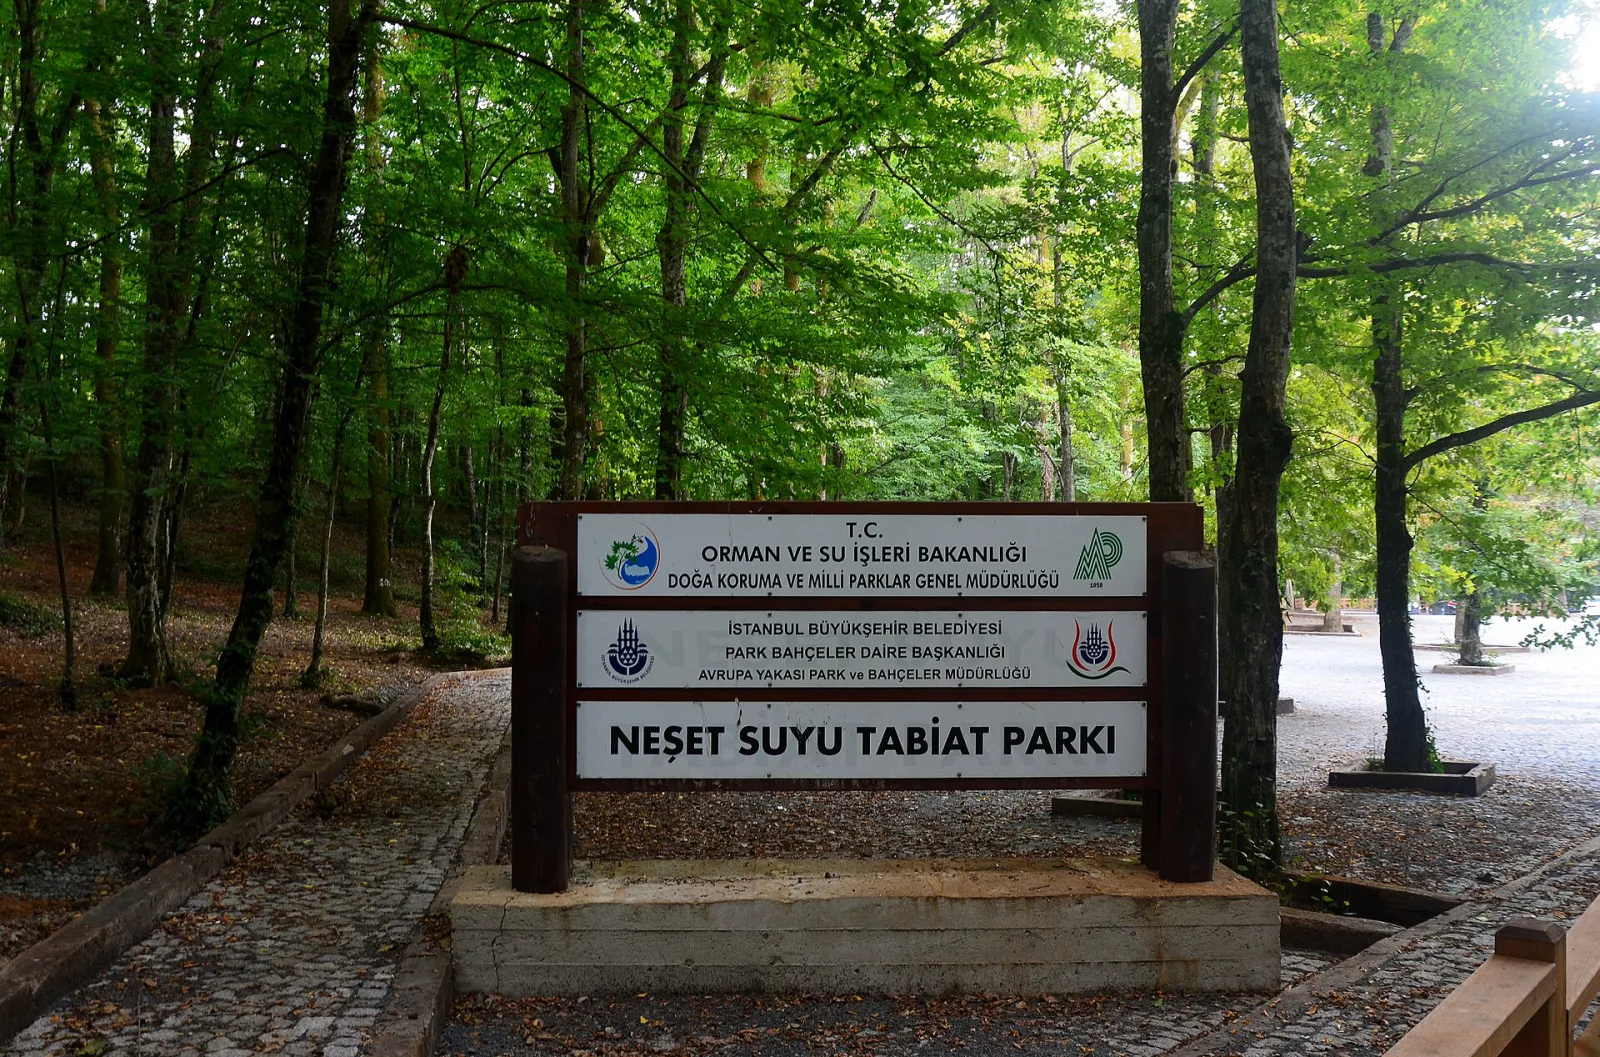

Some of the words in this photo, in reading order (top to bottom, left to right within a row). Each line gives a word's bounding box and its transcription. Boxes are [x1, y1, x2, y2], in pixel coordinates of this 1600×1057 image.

[846, 522, 883, 538] T.C.
[702, 545, 780, 562] ORMAN
[787, 546, 812, 562] VE
[819, 545, 846, 562] SU
[853, 541, 910, 566] İŞLERİ
[918, 541, 1027, 562] BAKANLIĞI
[668, 569, 713, 589] DOĞA
[718, 573, 782, 588] KORUMA
[786, 573, 804, 588] VE
[808, 569, 844, 588] MİLLİ
[849, 573, 911, 588] PARKLAR
[915, 573, 962, 589] GENEL
[966, 569, 1059, 589] MÜDÜRLÜĞÜ
[728, 620, 805, 636] İSTANBUL
[808, 620, 909, 638] BÜYÜKŞEHİR
[913, 620, 1002, 635] BELEDİYESİ
[725, 647, 767, 659] PARK
[772, 647, 856, 662] BAHÇELER
[860, 644, 907, 659] DAİRE
[912, 643, 1005, 661] BAŞKANLIĞI
[699, 669, 753, 680] AVRUPA
[756, 669, 805, 680] YAKASI
[809, 669, 846, 680] PARK
[850, 671, 864, 680] ve
[868, 669, 942, 683] BAHÇELER
[945, 666, 1031, 680] MÜDÜRLÜĞÜ
[610, 726, 725, 764] NEŞET
[738, 726, 842, 756] SUYU
[856, 716, 990, 756] TABİAT
[1003, 725, 1115, 755] PARKI
